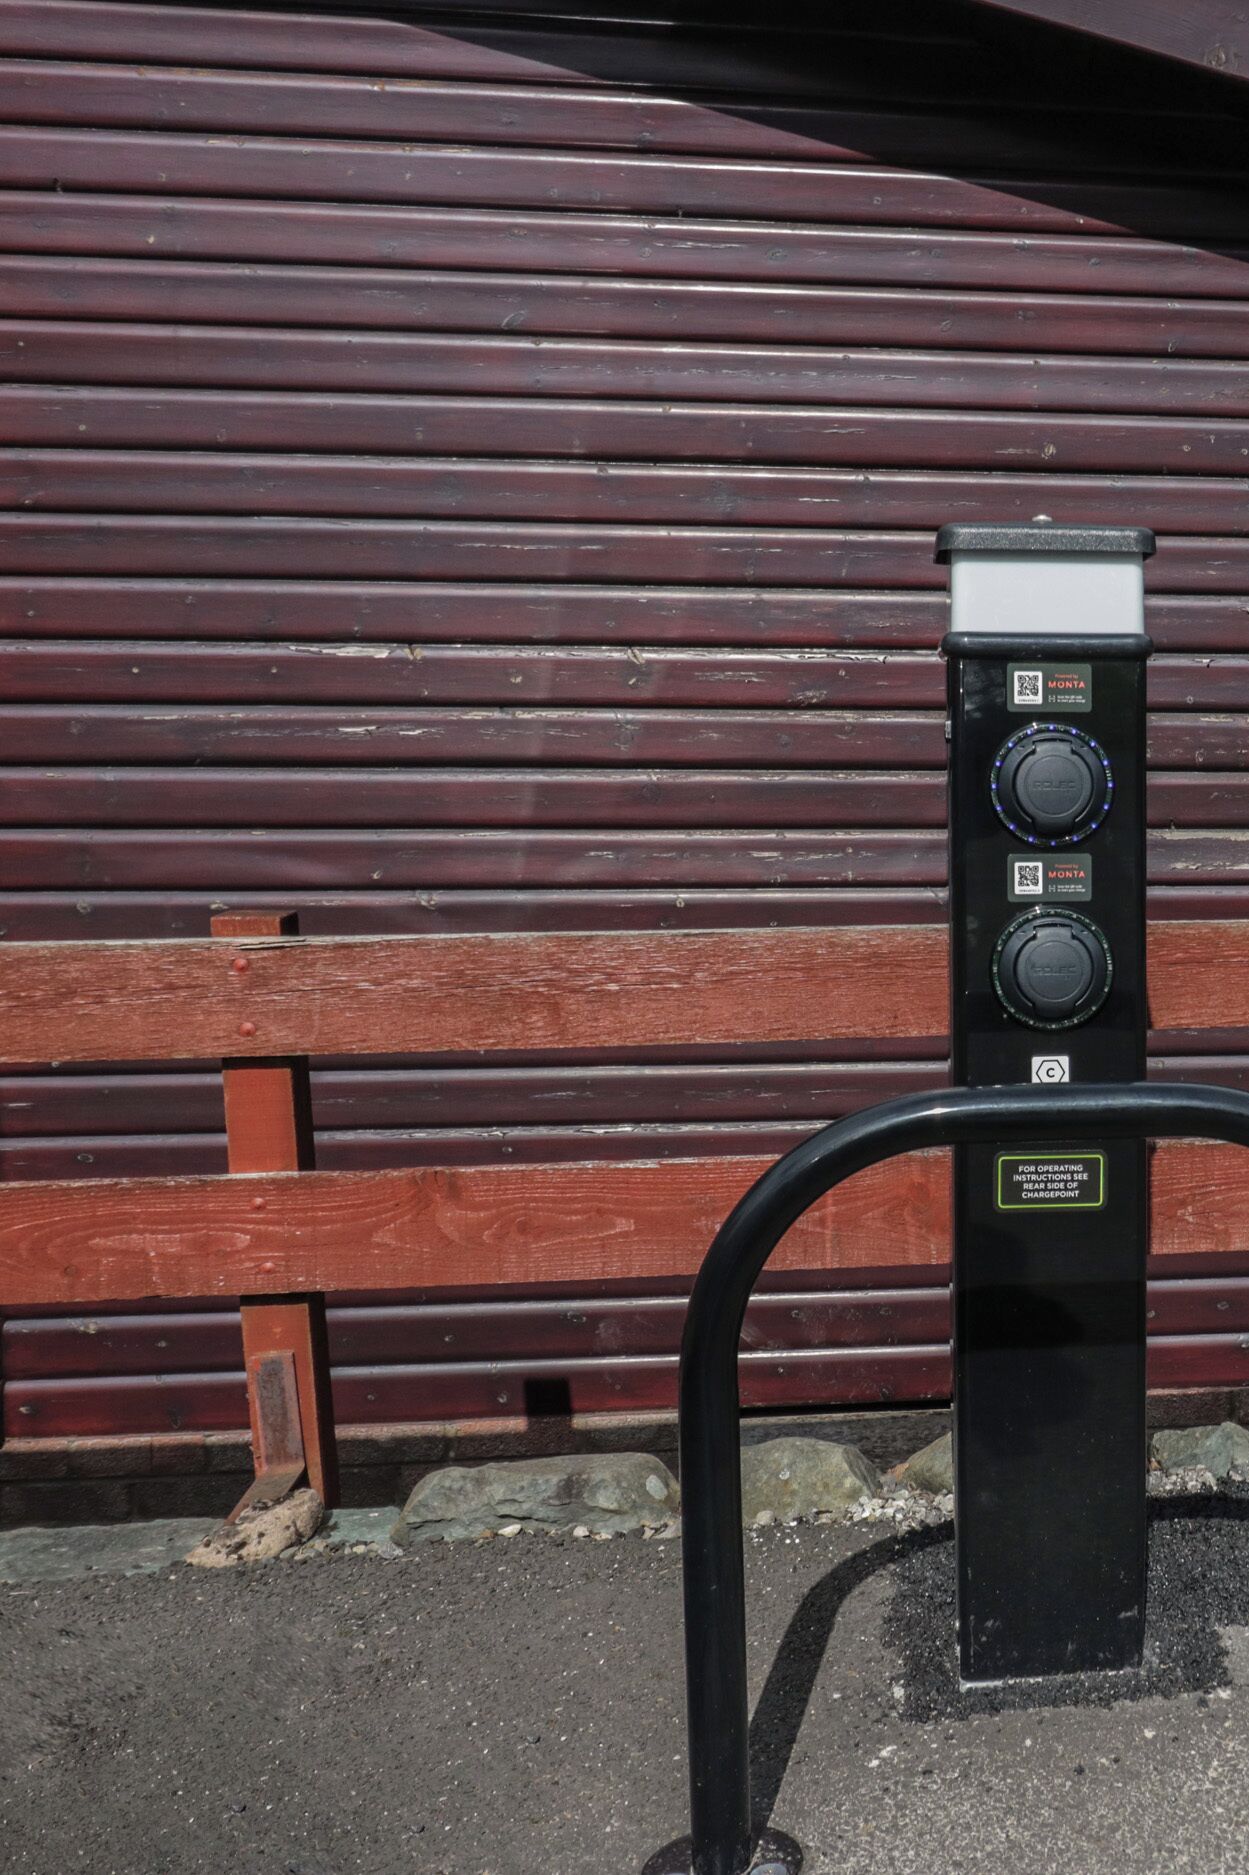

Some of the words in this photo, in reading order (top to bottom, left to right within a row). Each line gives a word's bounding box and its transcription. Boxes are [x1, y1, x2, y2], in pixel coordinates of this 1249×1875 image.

[1046, 1067, 1055, 1078] C
[1018, 1165, 1036, 1173] FOR
[1037, 1164, 1083, 1172] OPERATING
[1013, 1173, 1072, 1182] INSTRUCTIONS
[1023, 1182, 1045, 1190] REAR
[1021, 1190, 1080, 1199] CHARGEPOINT
